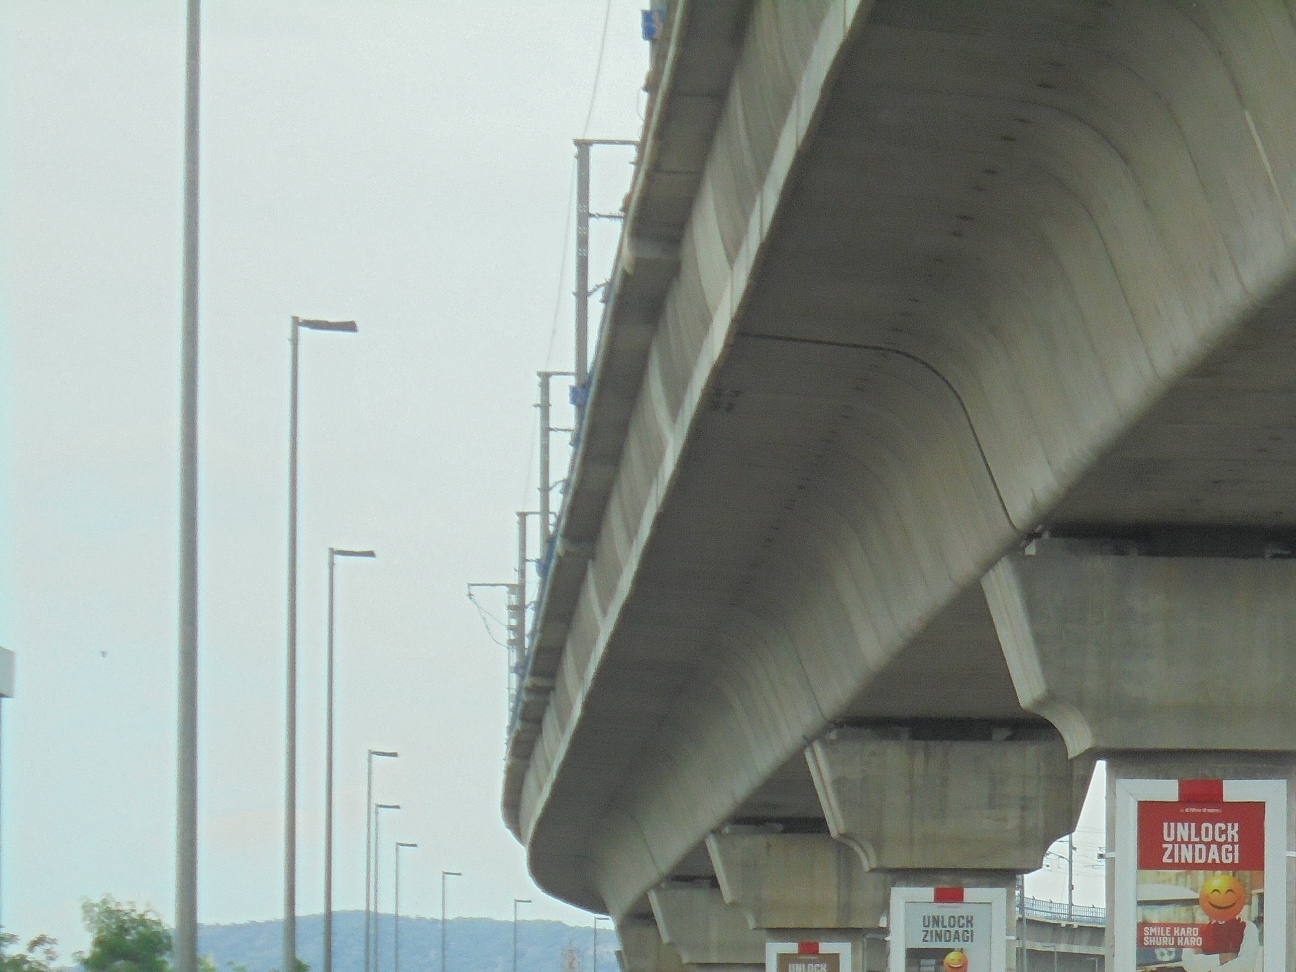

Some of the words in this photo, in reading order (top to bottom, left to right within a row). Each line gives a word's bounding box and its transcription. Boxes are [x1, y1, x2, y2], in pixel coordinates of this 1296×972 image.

[1162, 822, 1239, 844] UNLOCK
[1162, 844, 1239, 865] ZINDAGI
[922, 915, 974, 929] UNLOCK
[922, 929, 975, 943] ZINDAGI
[1143, 926, 1171, 938] SMILE
[1173, 926, 1199, 938] KARO
[1143, 936, 1175, 947] SHURU
[1177, 936, 1203, 947] KARO
